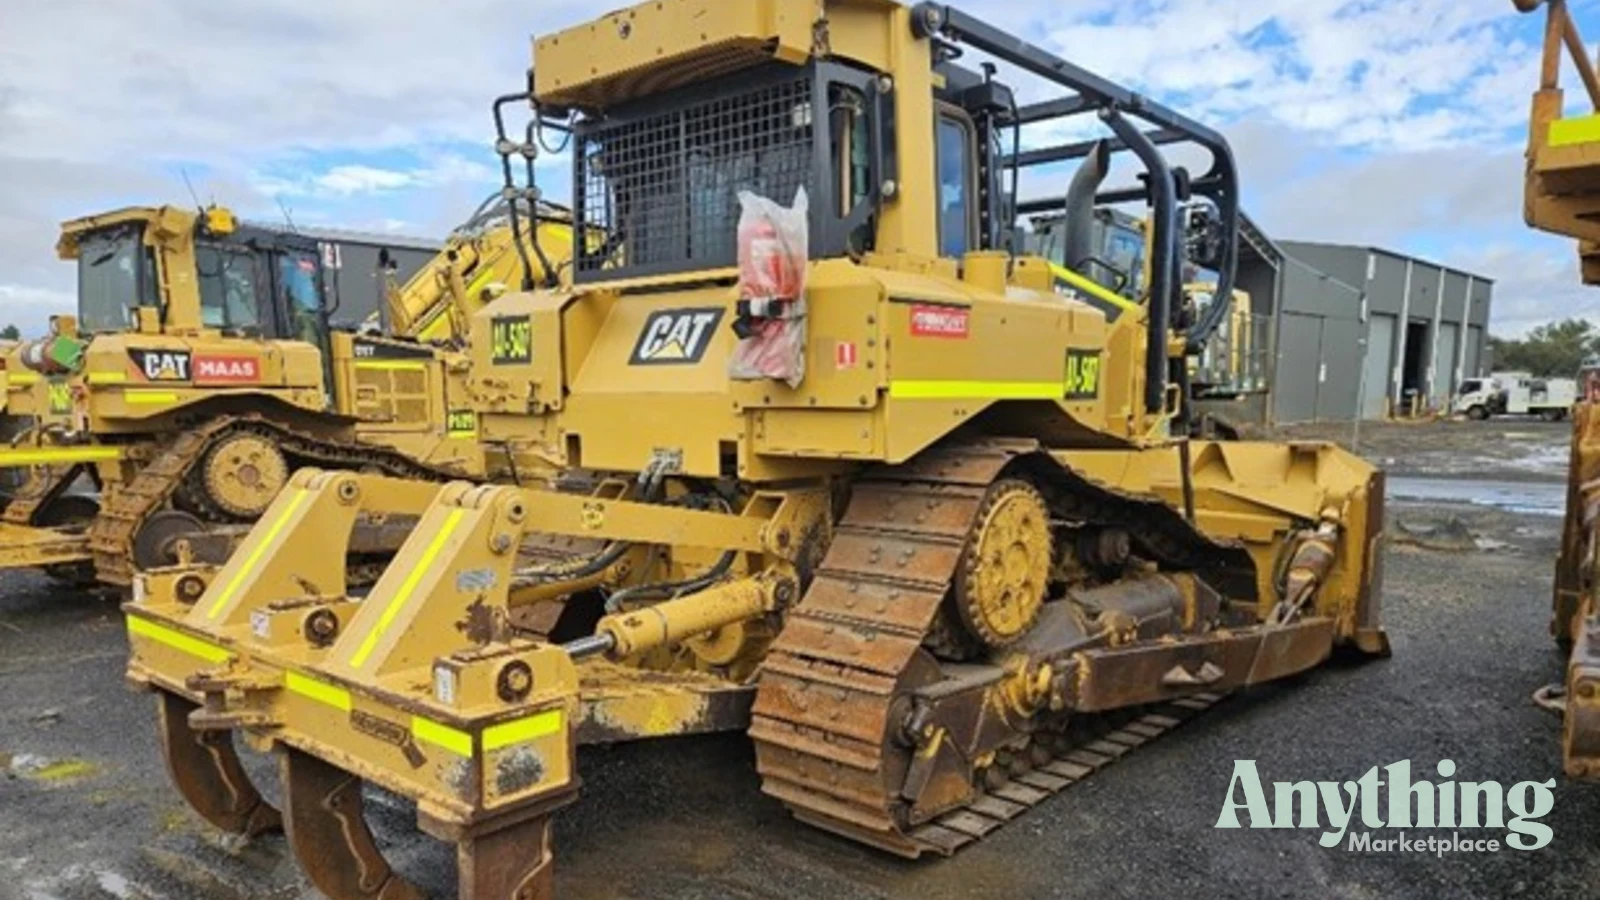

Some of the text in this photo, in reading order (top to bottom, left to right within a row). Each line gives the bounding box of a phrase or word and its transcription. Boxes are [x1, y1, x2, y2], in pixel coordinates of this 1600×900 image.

[640, 312, 716, 360] CAT
[144, 353, 189, 379] CAT
[199, 361, 255, 377] MAAS
